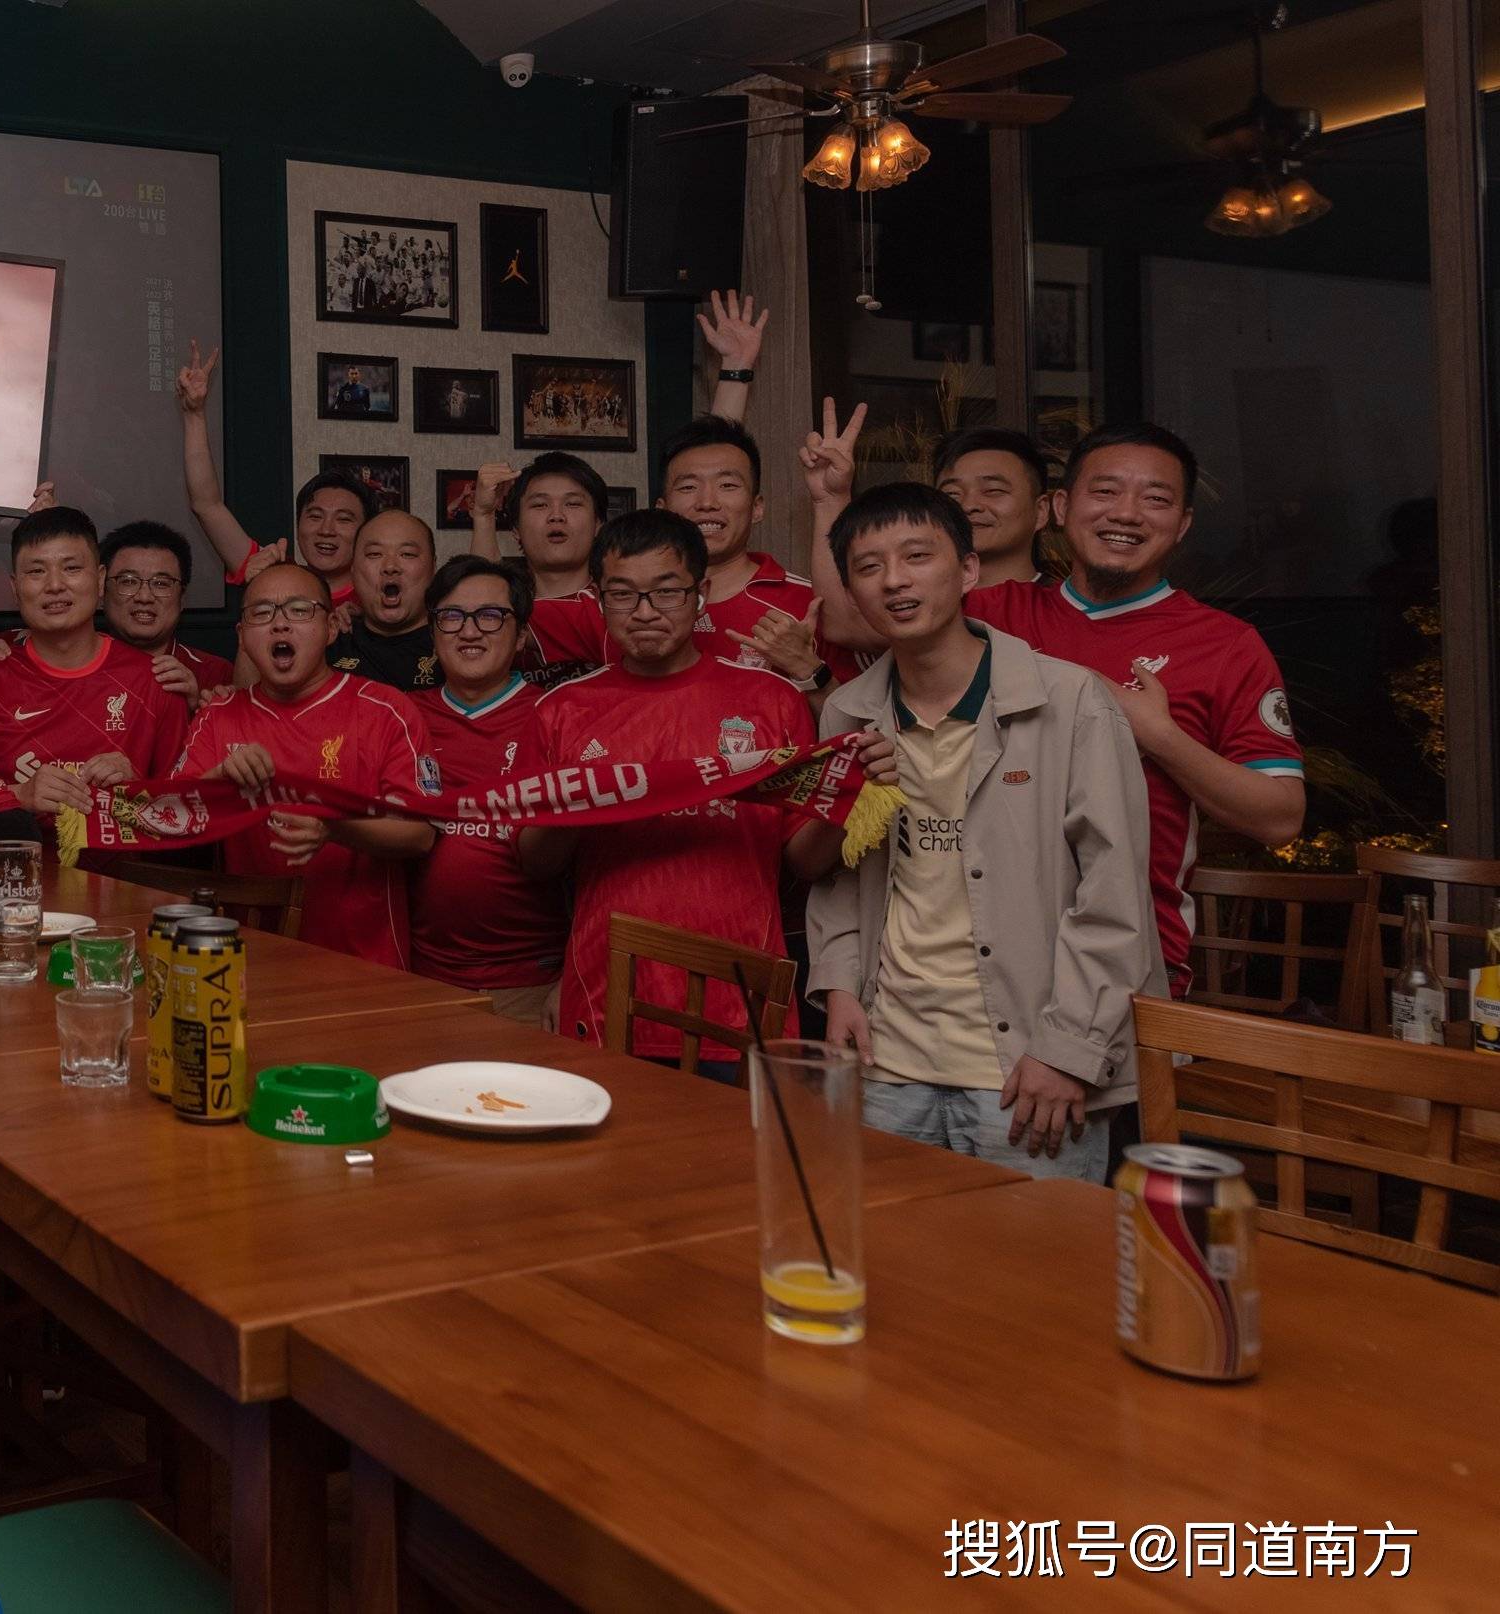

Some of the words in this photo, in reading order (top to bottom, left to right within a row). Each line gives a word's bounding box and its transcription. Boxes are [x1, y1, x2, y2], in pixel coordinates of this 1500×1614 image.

[580, 749, 609, 761] adidas
[456, 763, 649, 822] ANFIELD
[202, 963, 232, 1111] SUPRA
[275, 1119, 325, 1136] Heineken
